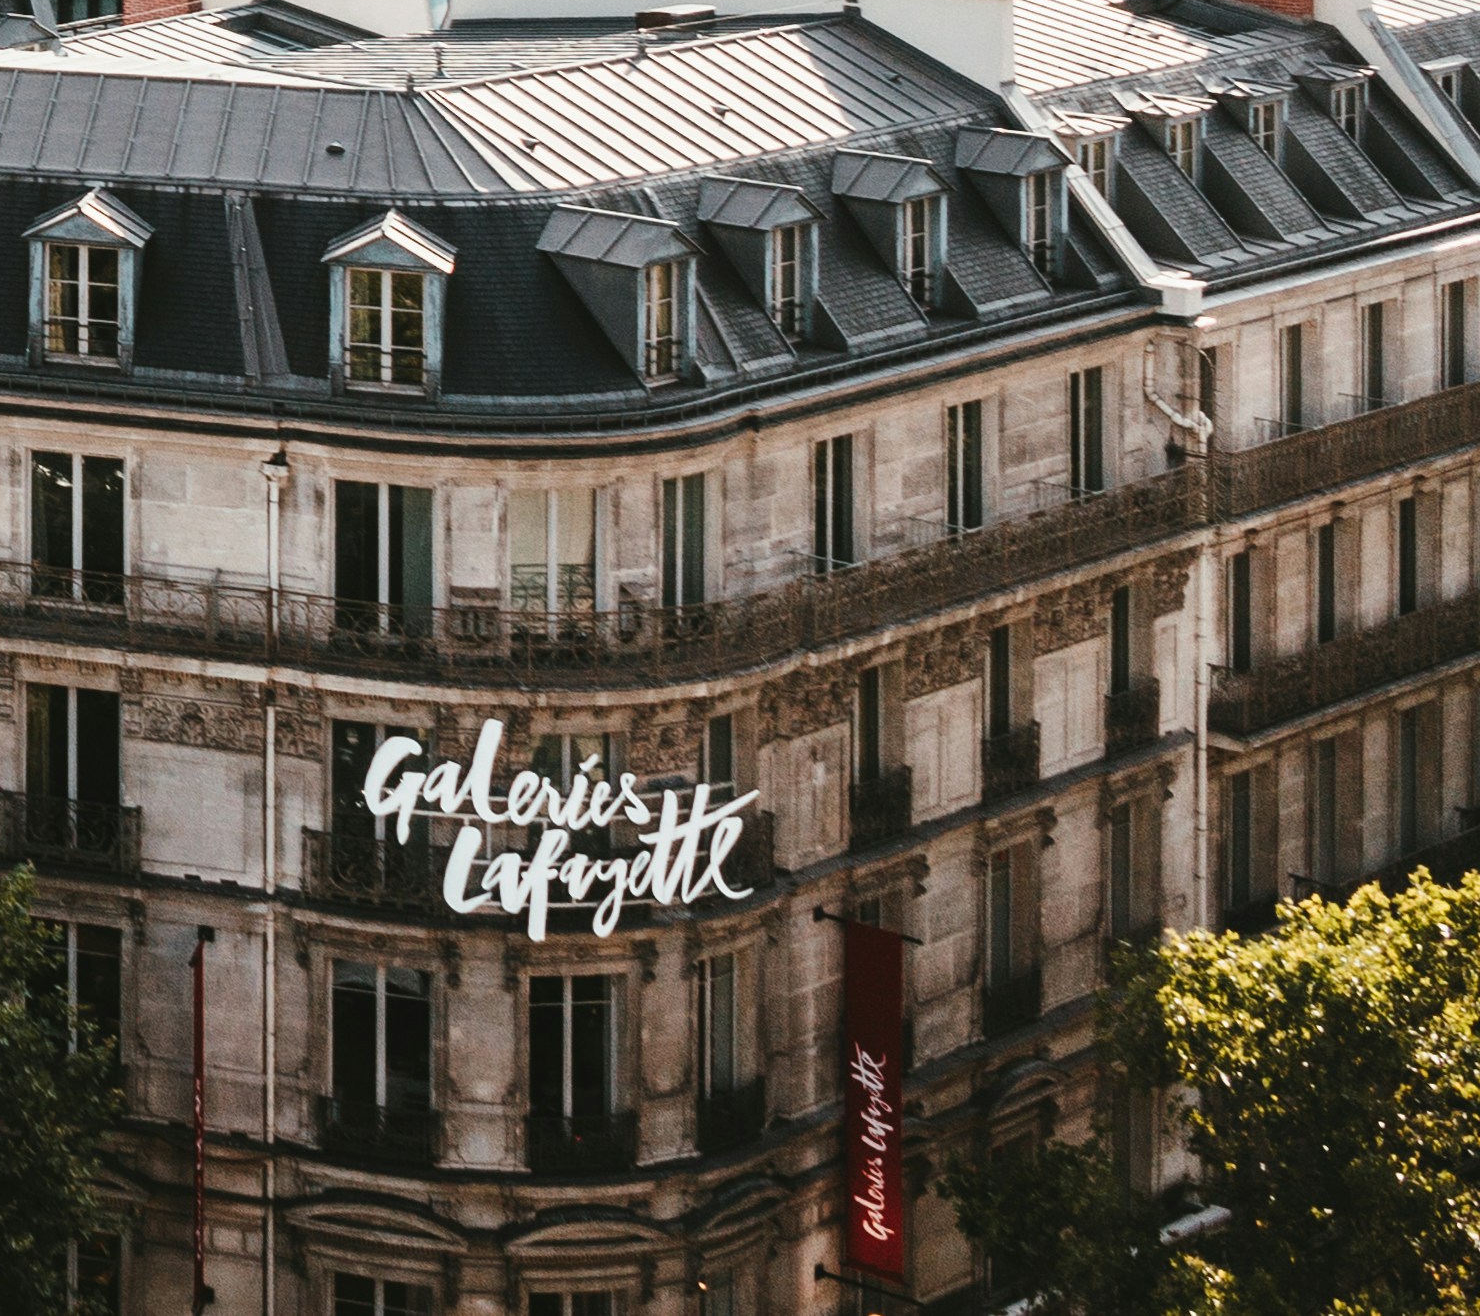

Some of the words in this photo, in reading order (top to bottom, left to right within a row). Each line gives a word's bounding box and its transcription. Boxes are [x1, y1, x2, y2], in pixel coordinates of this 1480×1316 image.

[362, 718, 651, 845] Galeries
[443, 783, 760, 943] Lafayette
[850, 1041, 895, 1152] Lafayette
[853, 1156, 896, 1241] Galeries
